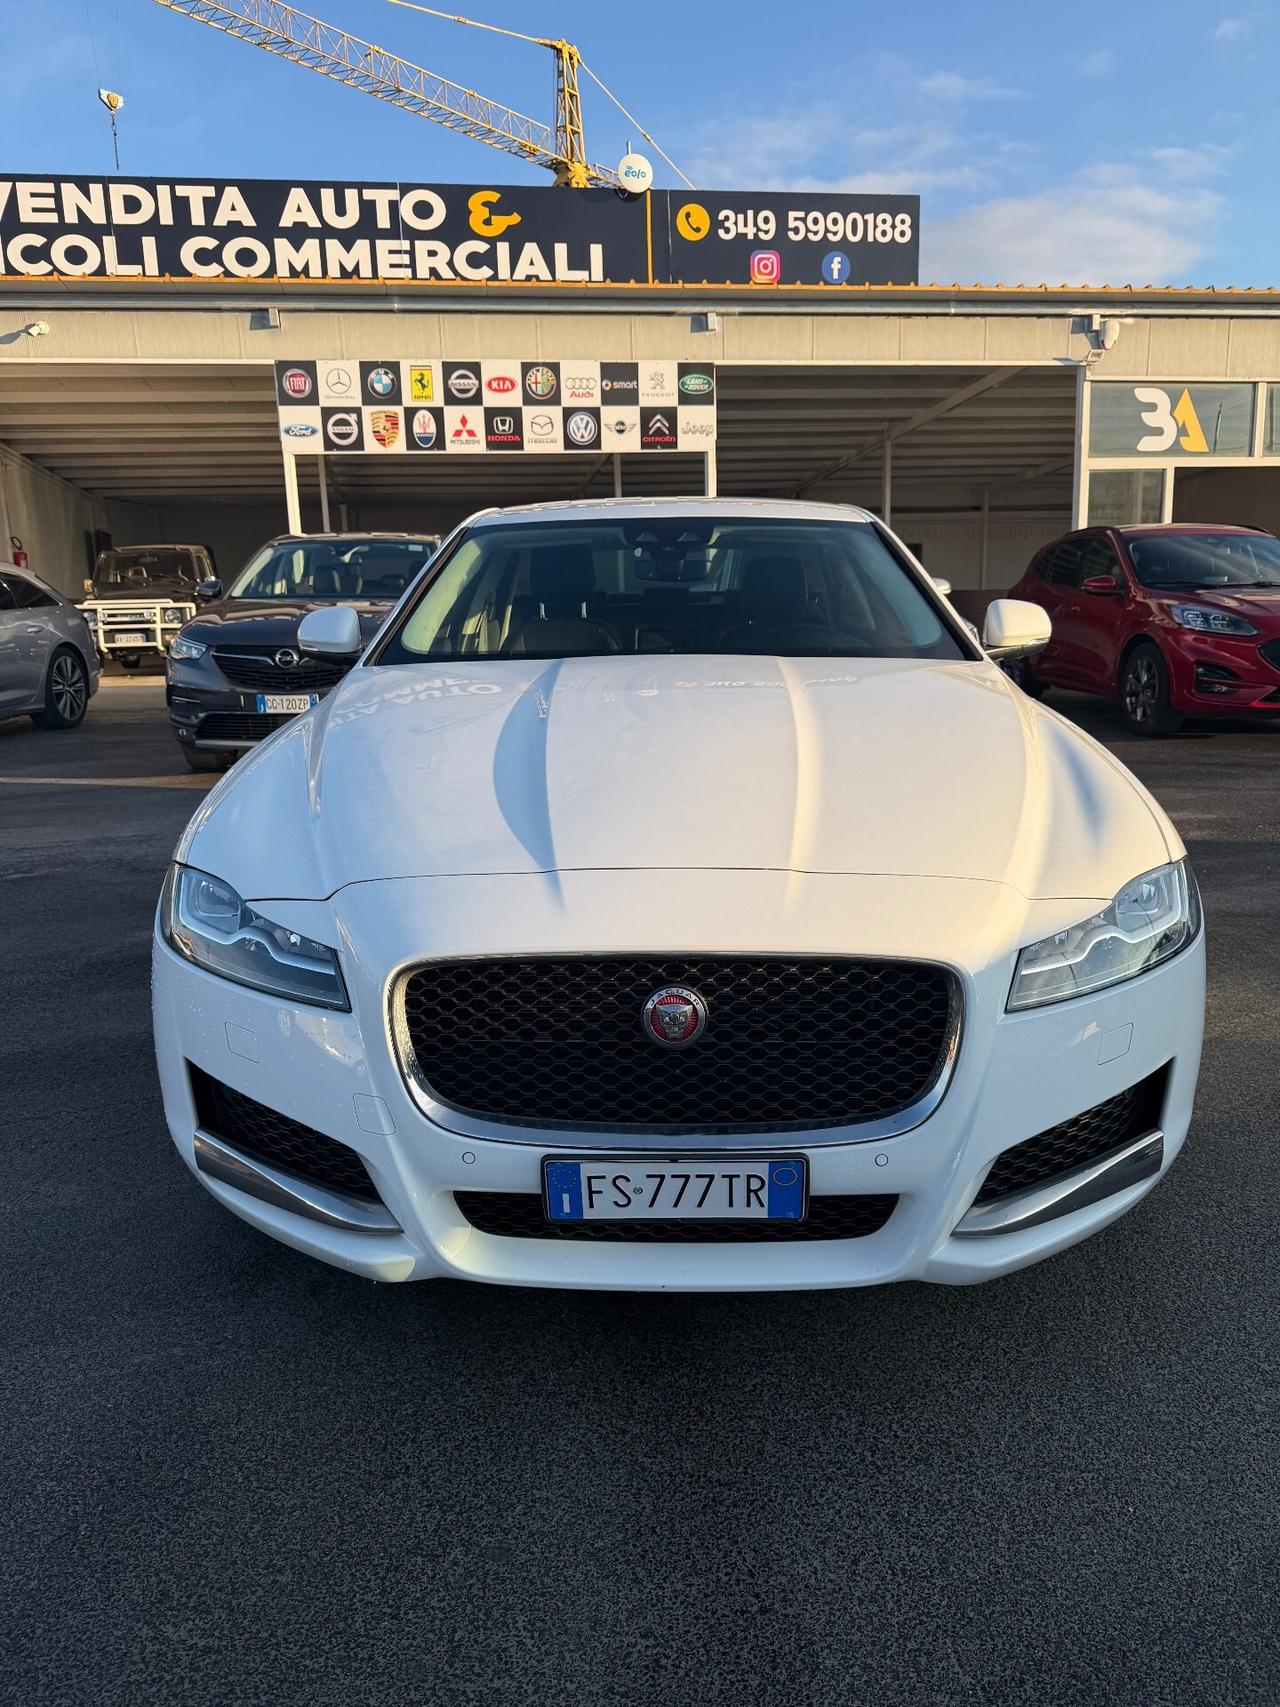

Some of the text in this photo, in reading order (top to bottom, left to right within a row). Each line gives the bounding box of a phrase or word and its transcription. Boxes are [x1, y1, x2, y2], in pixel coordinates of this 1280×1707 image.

[279, 187, 447, 231] AUTO
[467, 190, 523, 237] &
[717, 209, 912, 243] 349 5990188
[0, 233, 604, 281] COLI COMMERCIALI
[289, 377, 306, 390] FIAT
[491, 380, 512, 390] KIA
[612, 380, 638, 389] smart
[569, 390, 594, 399] Audi
[289, 425, 312, 436] Ford
[650, 988, 700, 1007] JAGUAR
